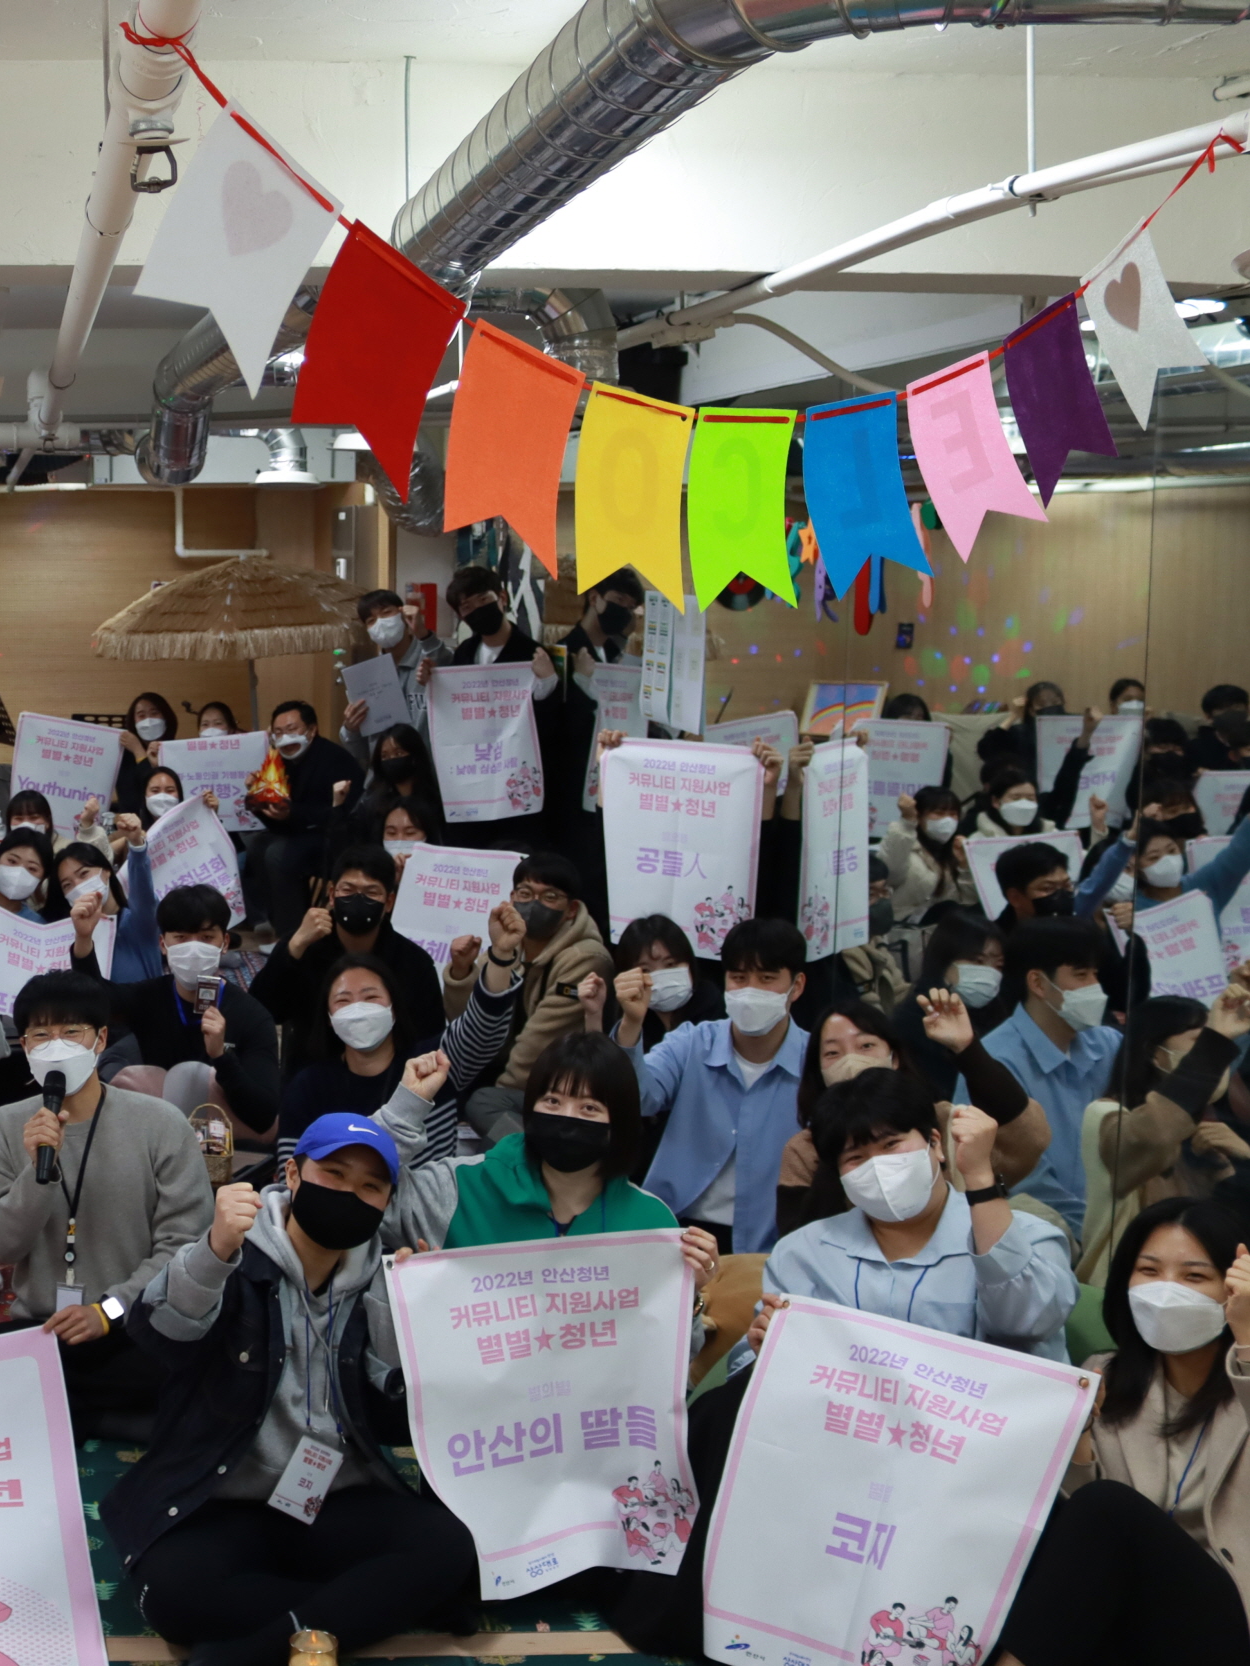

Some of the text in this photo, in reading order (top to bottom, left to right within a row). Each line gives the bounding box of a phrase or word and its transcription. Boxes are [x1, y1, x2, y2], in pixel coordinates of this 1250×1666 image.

[628, 772, 731, 796] 커뮤니티 지원사업
[643, 759, 676, 771] 2022년
[415, 873, 500, 895] 커뮤니티 지원사업
[471, 1265, 610, 1293] 2022년 안산청년
[450, 1286, 640, 1330] 커뮤니티 지원사업
[848, 1344, 988, 1399] 2022년 안산청년
[809, 1364, 1008, 1437] 커뮤니티 지원사업
[447, 1404, 657, 1477] 안산의 딸들
[825, 1512, 897, 1571] 코지
